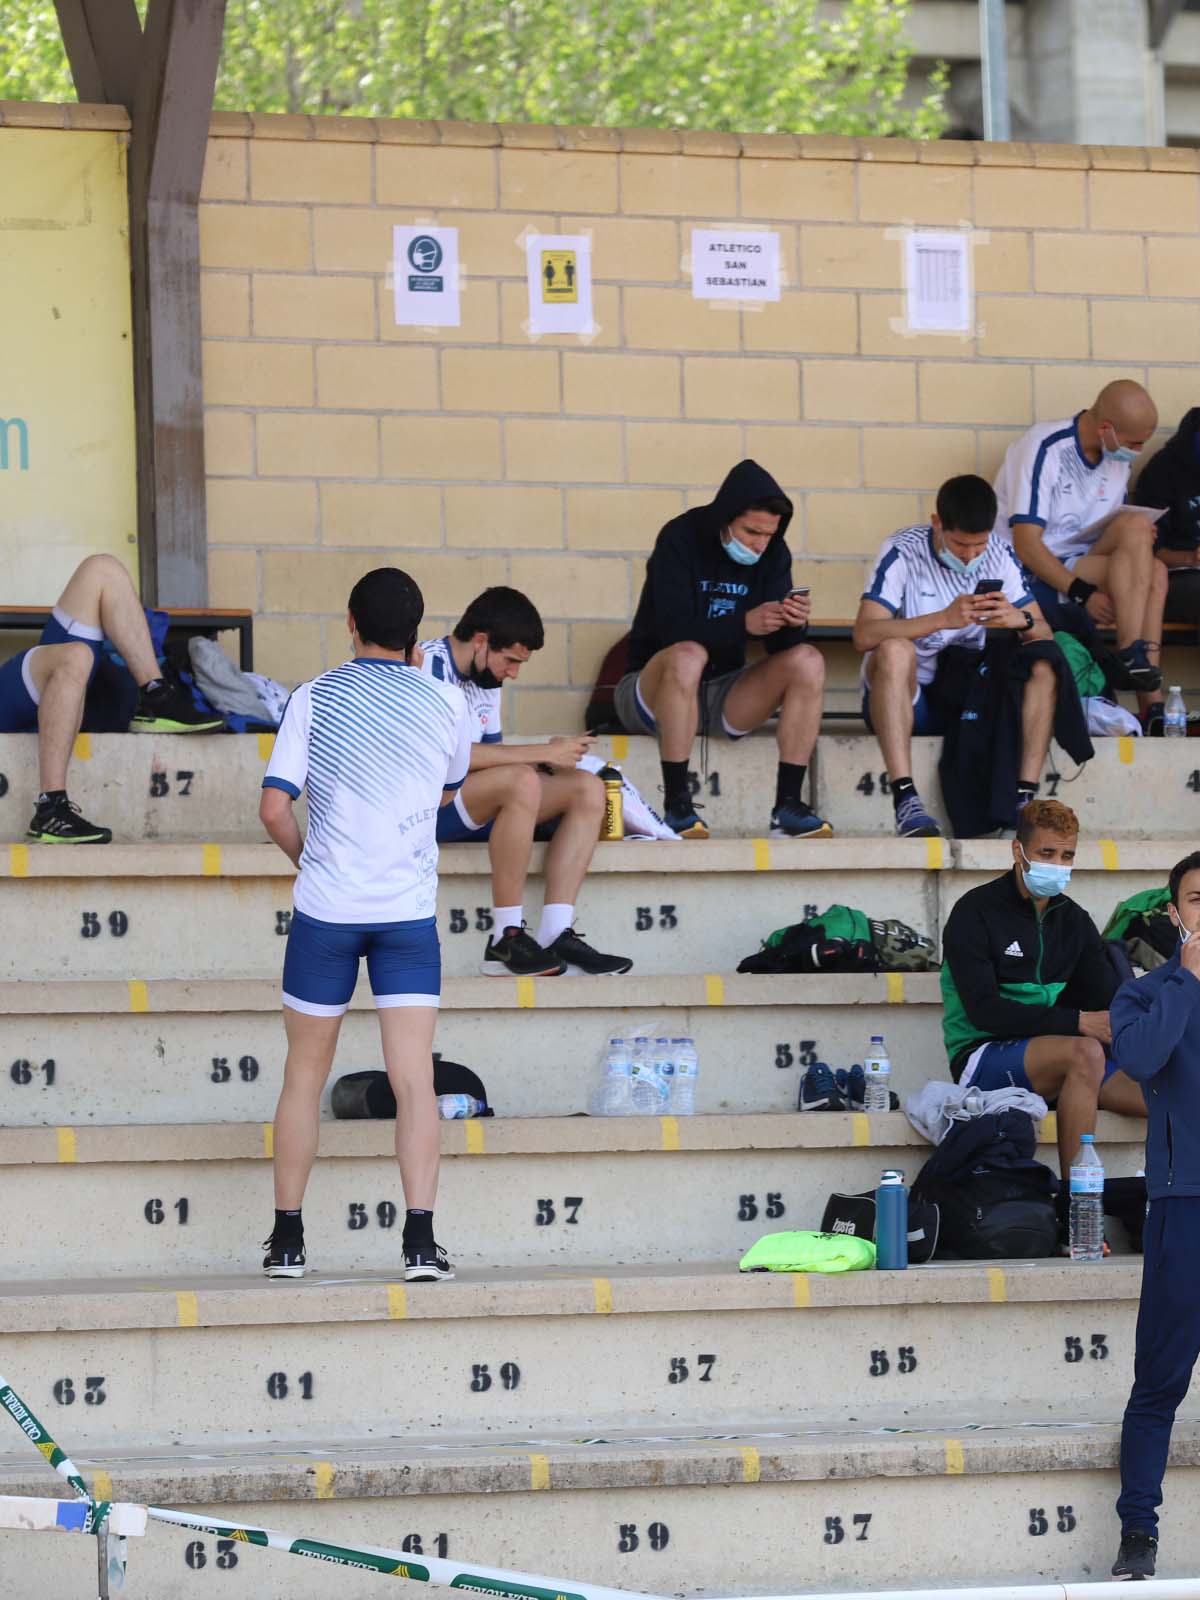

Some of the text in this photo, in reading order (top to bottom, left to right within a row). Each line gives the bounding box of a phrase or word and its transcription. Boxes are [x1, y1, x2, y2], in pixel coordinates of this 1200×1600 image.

[709, 243, 762, 254] ATLETICO
[725, 260, 747, 270] SAN
[706, 276, 767, 287] SEBASTIAN
[150, 771, 193, 797] 57
[1045, 773, 1059, 796] 7
[81, 911, 128, 938] 59
[275, 911, 290, 936] 5
[450, 909, 494, 933] 55
[636, 905, 677, 931] 53
[775, 1040, 817, 1068] 53
[11, 1059, 55, 1085] 61
[211, 1056, 259, 1083] 59
[145, 1198, 188, 1224] 61
[348, 1201, 396, 1230] 59
[536, 1197, 583, 1226] 57
[738, 1193, 785, 1221] 55
[870, 1347, 917, 1376] 55
[1065, 1334, 1108, 1362] 53
[471, 1362, 520, 1392] 59
[668, 1355, 715, 1384] 57
[53, 1377, 106, 1405] 63
[267, 1372, 312, 1400] 61
[3, 1390, 41, 1441] CAJA RURAL
[824, 1514, 872, 1544] 57
[1029, 1506, 1076, 1536] 55
[402, 1533, 448, 1558] 61
[619, 1523, 669, 1553] 59
[186, 1541, 239, 1570] 63
